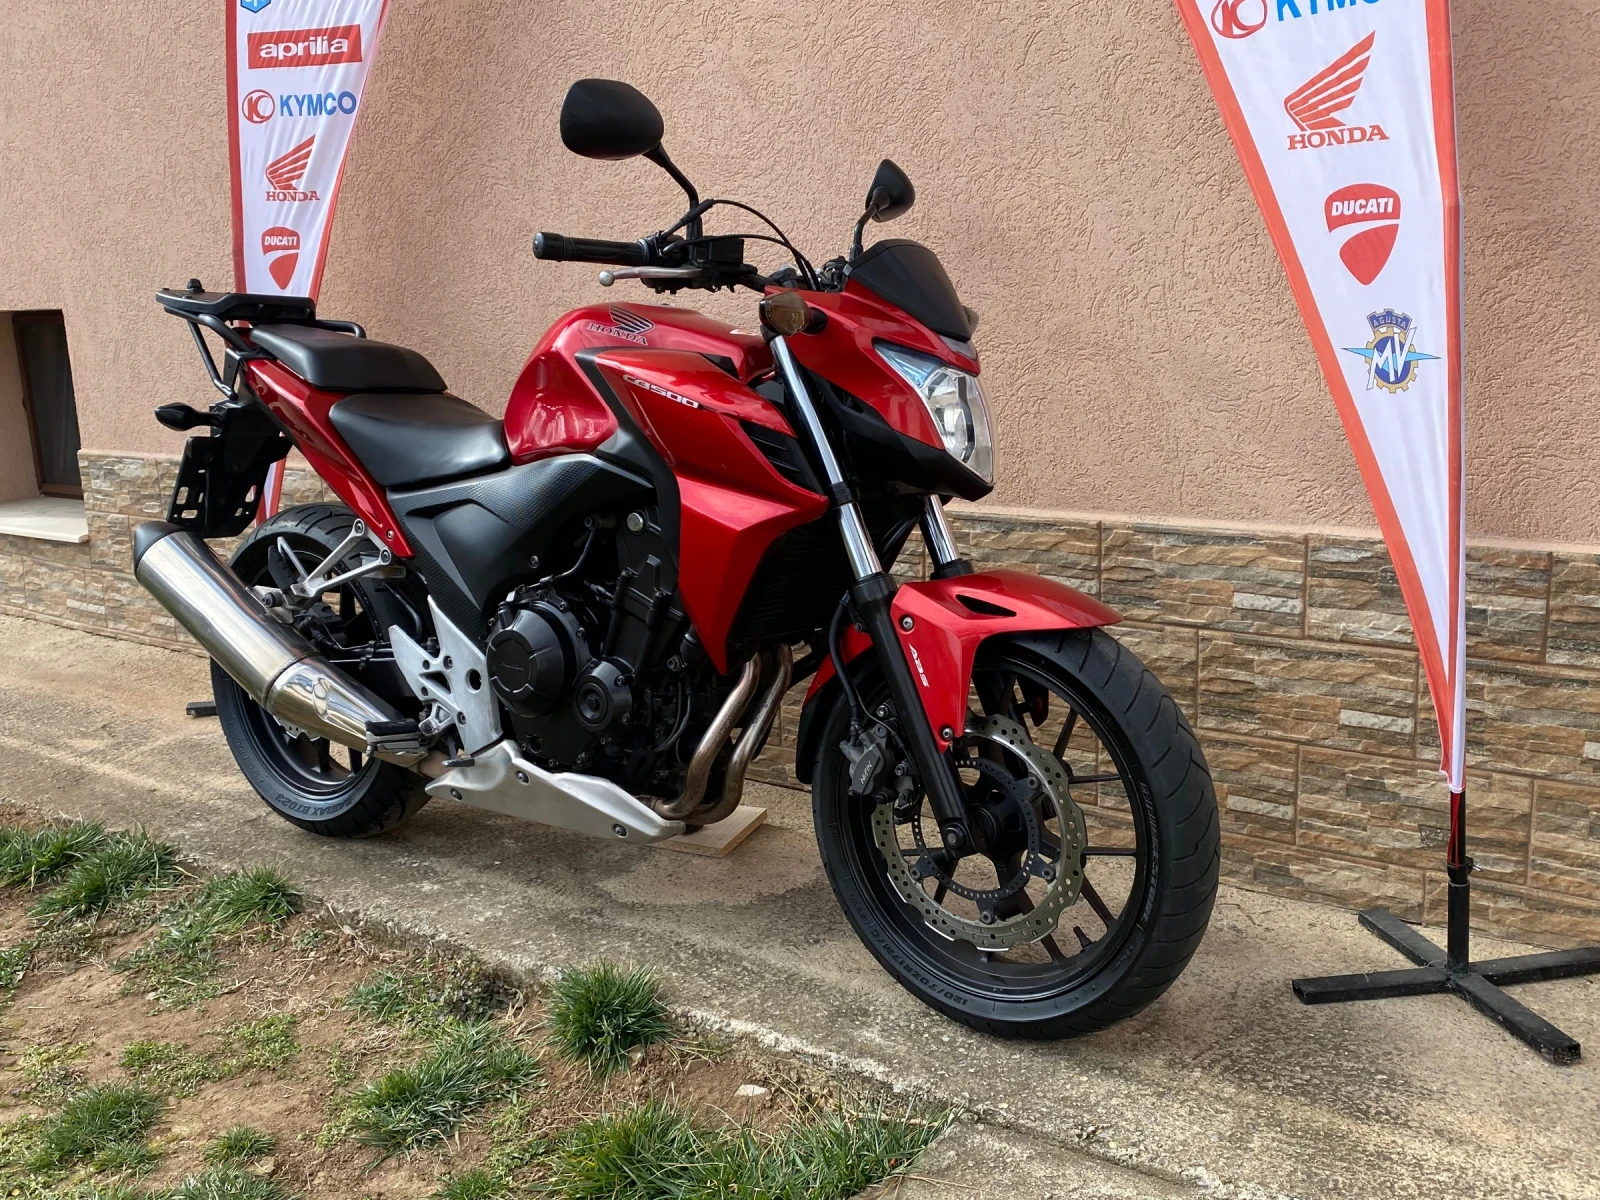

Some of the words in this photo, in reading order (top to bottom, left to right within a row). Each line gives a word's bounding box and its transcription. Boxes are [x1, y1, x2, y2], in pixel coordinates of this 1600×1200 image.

[259, 35, 349, 61] aprilia
[280, 91, 357, 117] KYMCO
[1287, 125, 1390, 150] HONDA
[266, 190, 320, 202] HONDA
[1331, 197, 1394, 216] DUCATI
[264, 236, 297, 247] DUCATI
[1372, 314, 1408, 329] AGUSTA
[586, 322, 649, 346] HONDA
[1366, 327, 1417, 391] MV
[622, 374, 699, 409] CB500
[907, 642, 931, 689] ABS
[275, 793, 312, 815] BT023
